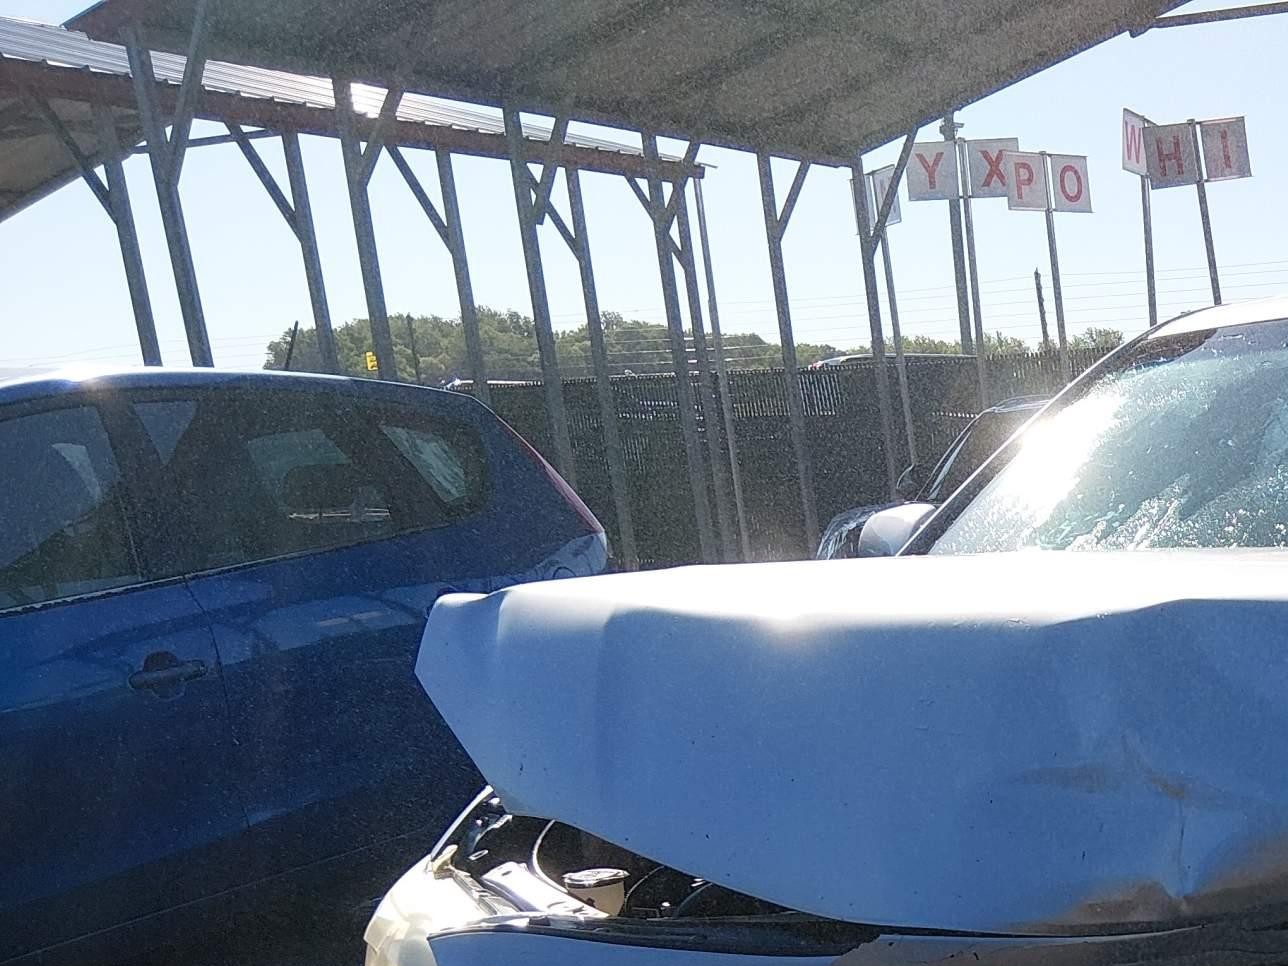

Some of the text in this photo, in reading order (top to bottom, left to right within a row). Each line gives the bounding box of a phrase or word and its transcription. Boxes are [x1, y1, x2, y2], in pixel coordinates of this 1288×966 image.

[914, 152, 945, 190] Y
[979, 150, 1007, 188] X
[1155, 134, 1185, 178] H
[1014, 162, 1036, 201] P
[1058, 164, 1084, 204] O
